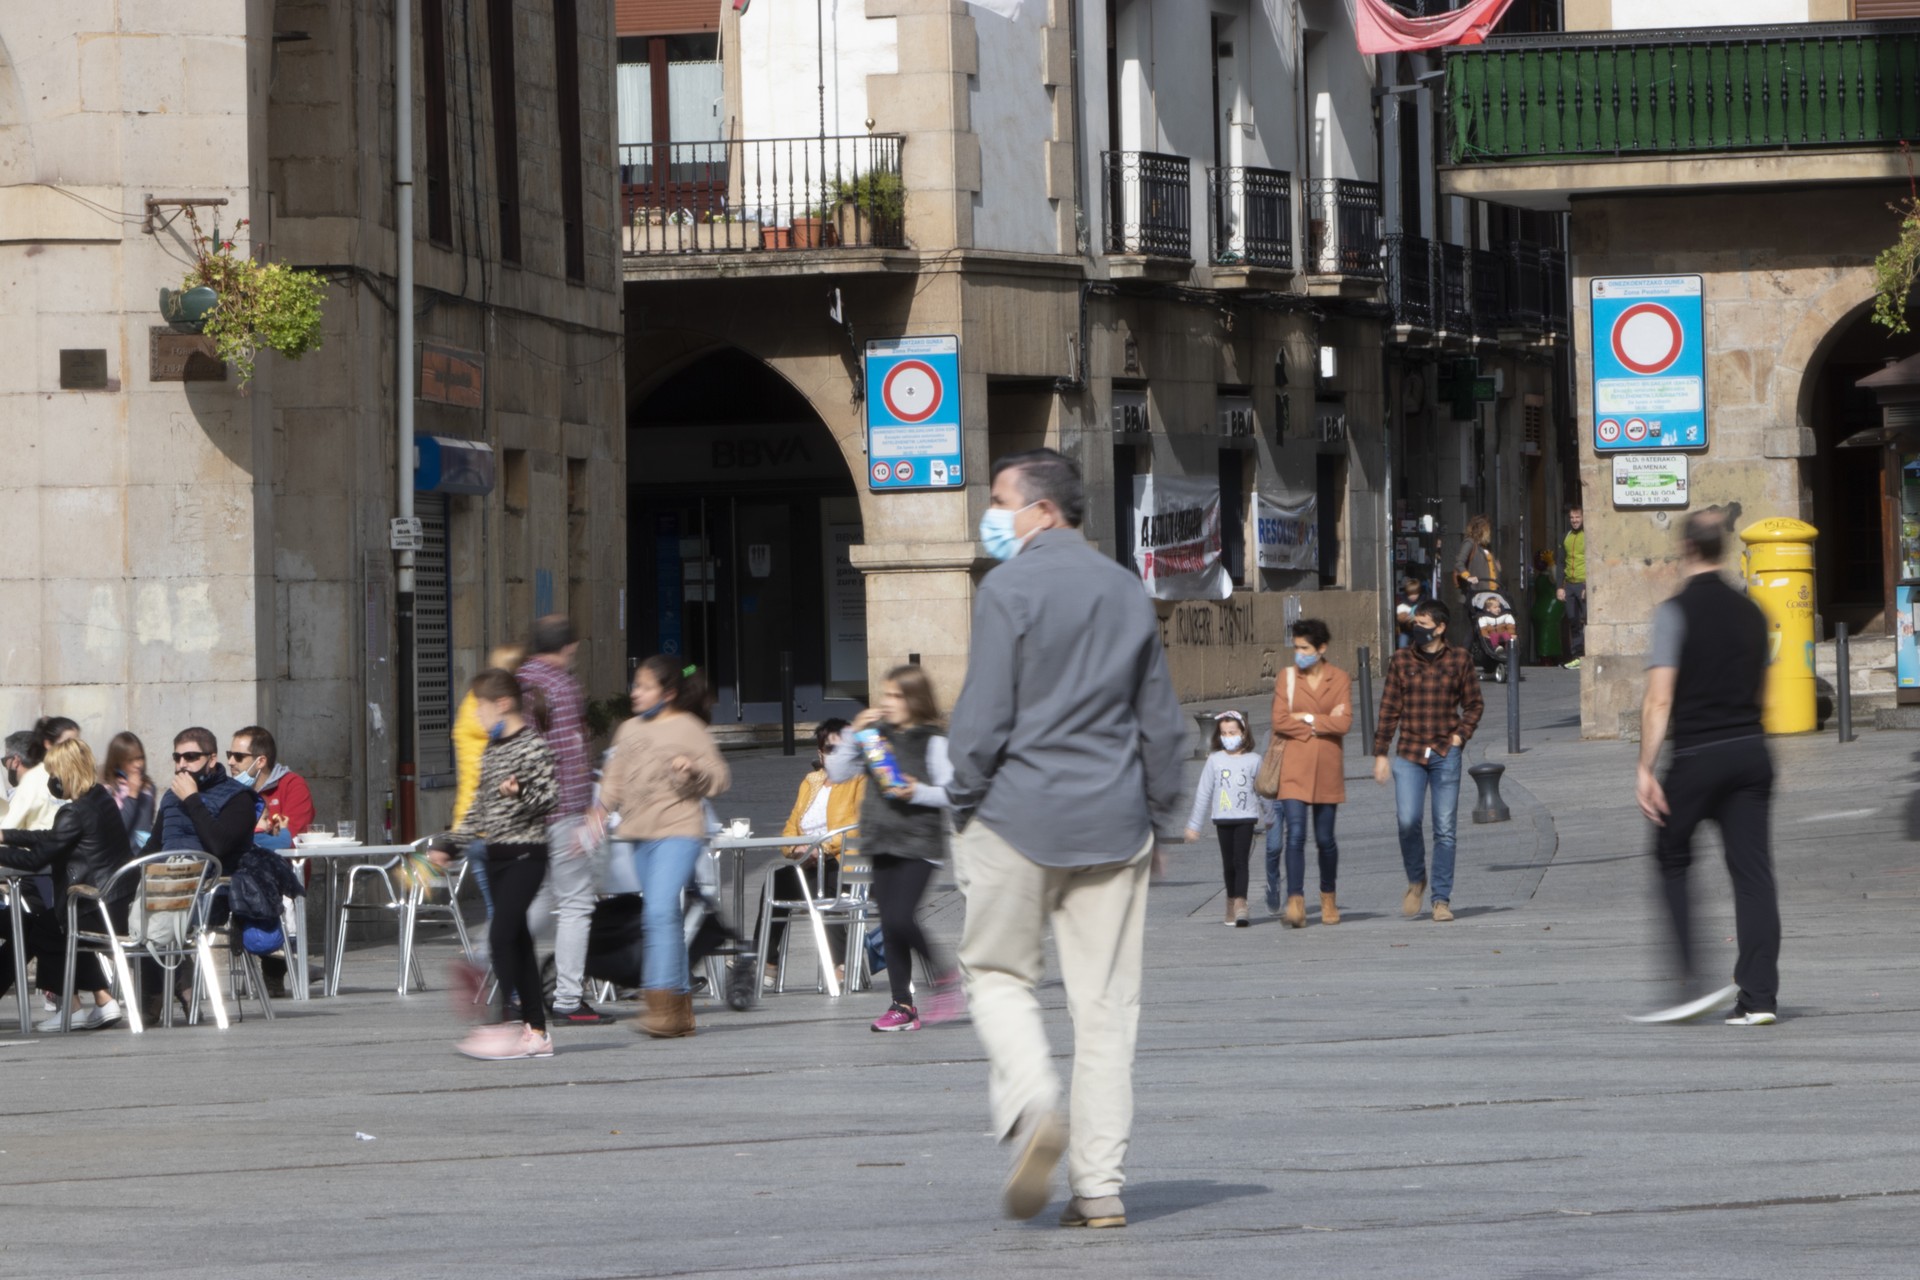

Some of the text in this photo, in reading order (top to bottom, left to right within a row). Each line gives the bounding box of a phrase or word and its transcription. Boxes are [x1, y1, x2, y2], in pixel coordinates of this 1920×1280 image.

[1602, 426, 1615, 435] 10
[711, 434, 813, 469] BBVA
[876, 468, 886, 476] 10
